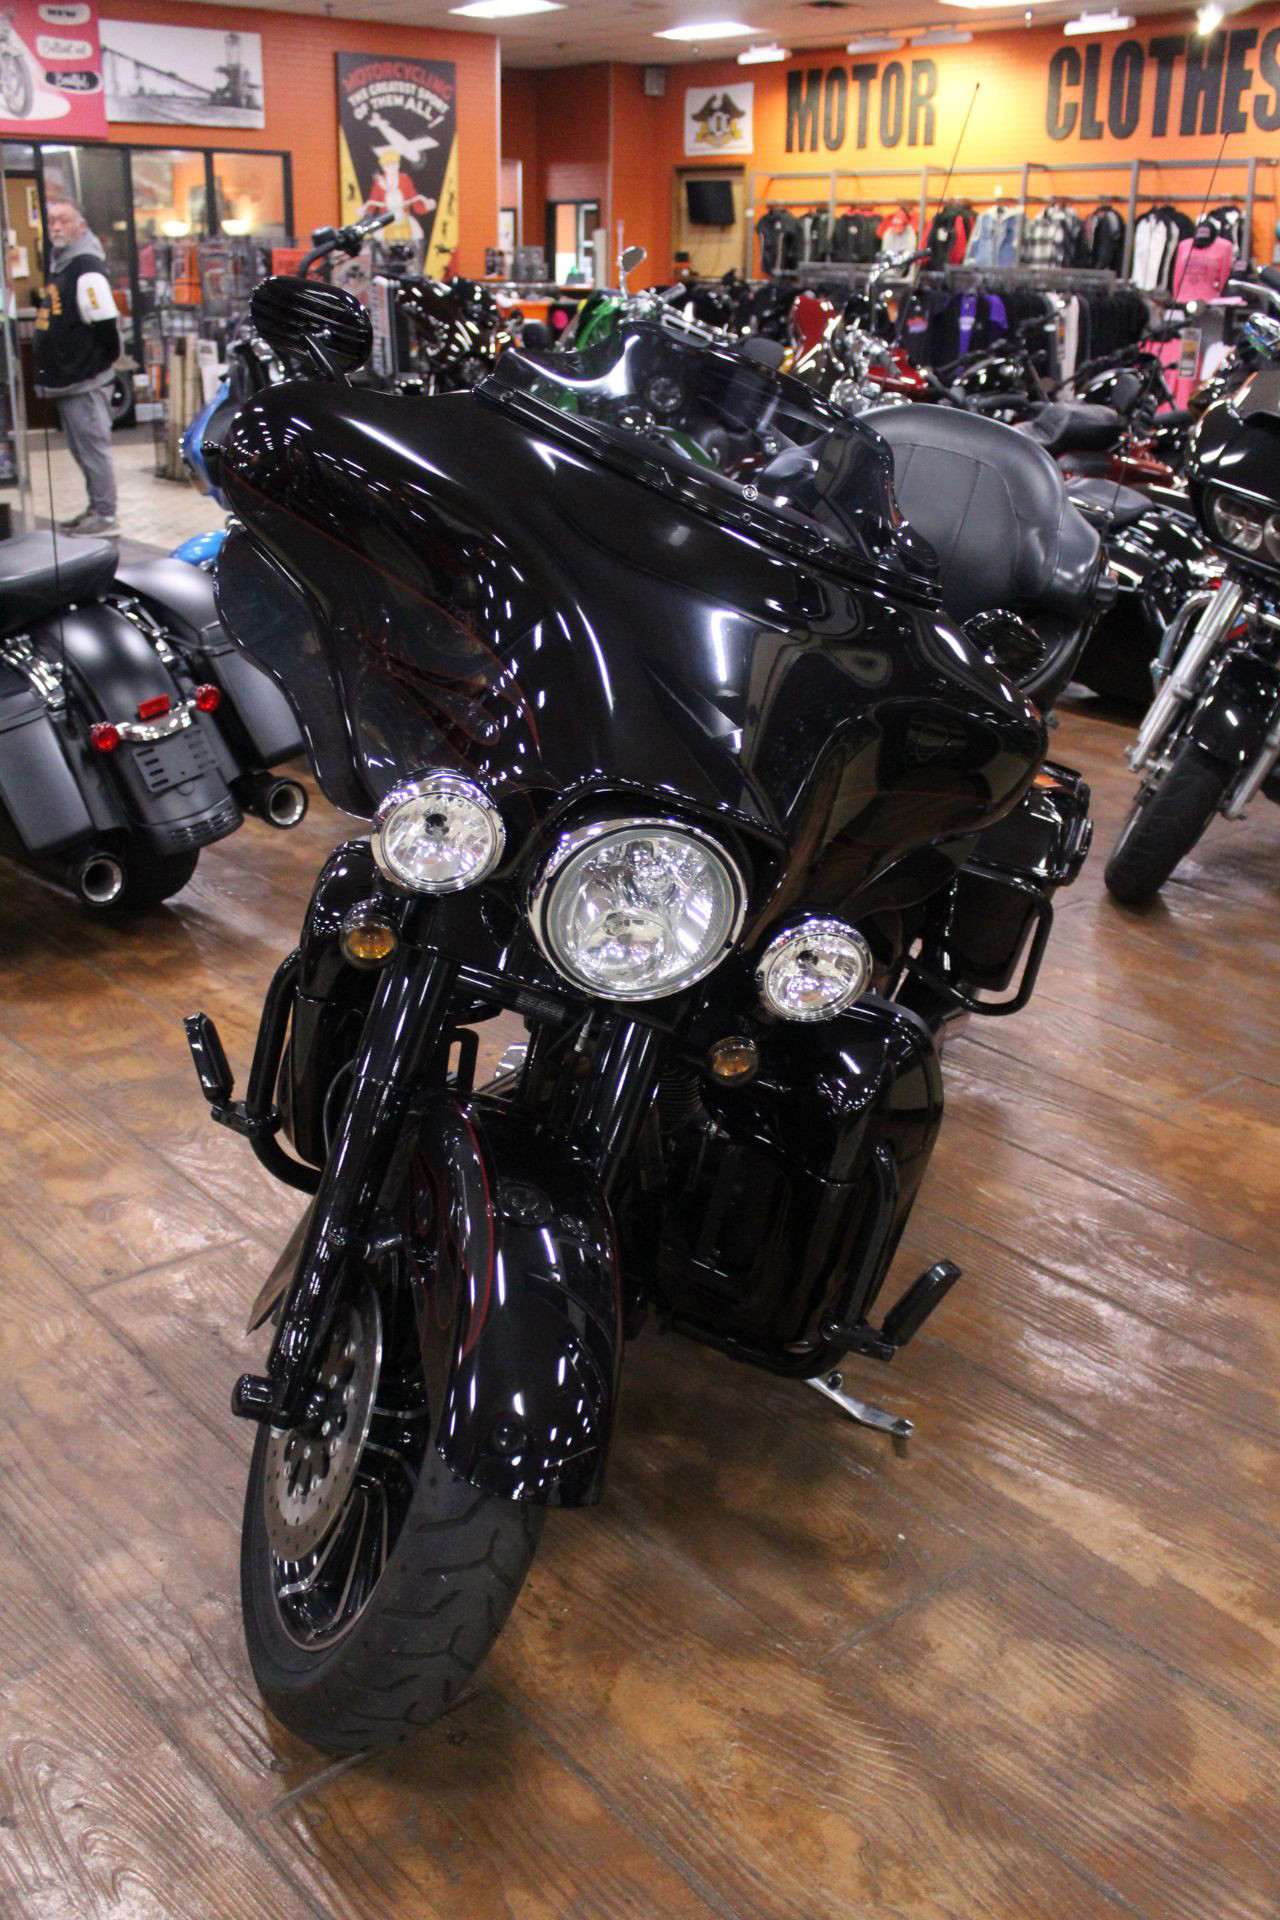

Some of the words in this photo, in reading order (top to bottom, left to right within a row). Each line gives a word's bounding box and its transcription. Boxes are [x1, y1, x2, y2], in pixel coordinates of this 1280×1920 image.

[343, 61, 453, 101] MOTORCYCLING
[347, 87, 369, 107] THE
[368, 80, 417, 97] GREATEST
[417, 86, 450, 114] SPORT
[784, 59, 938, 153] MOTOR
[1046, 27, 1280, 141] CLOTHES
[353, 102, 369, 120] OF
[369, 94, 405, 110] THEM
